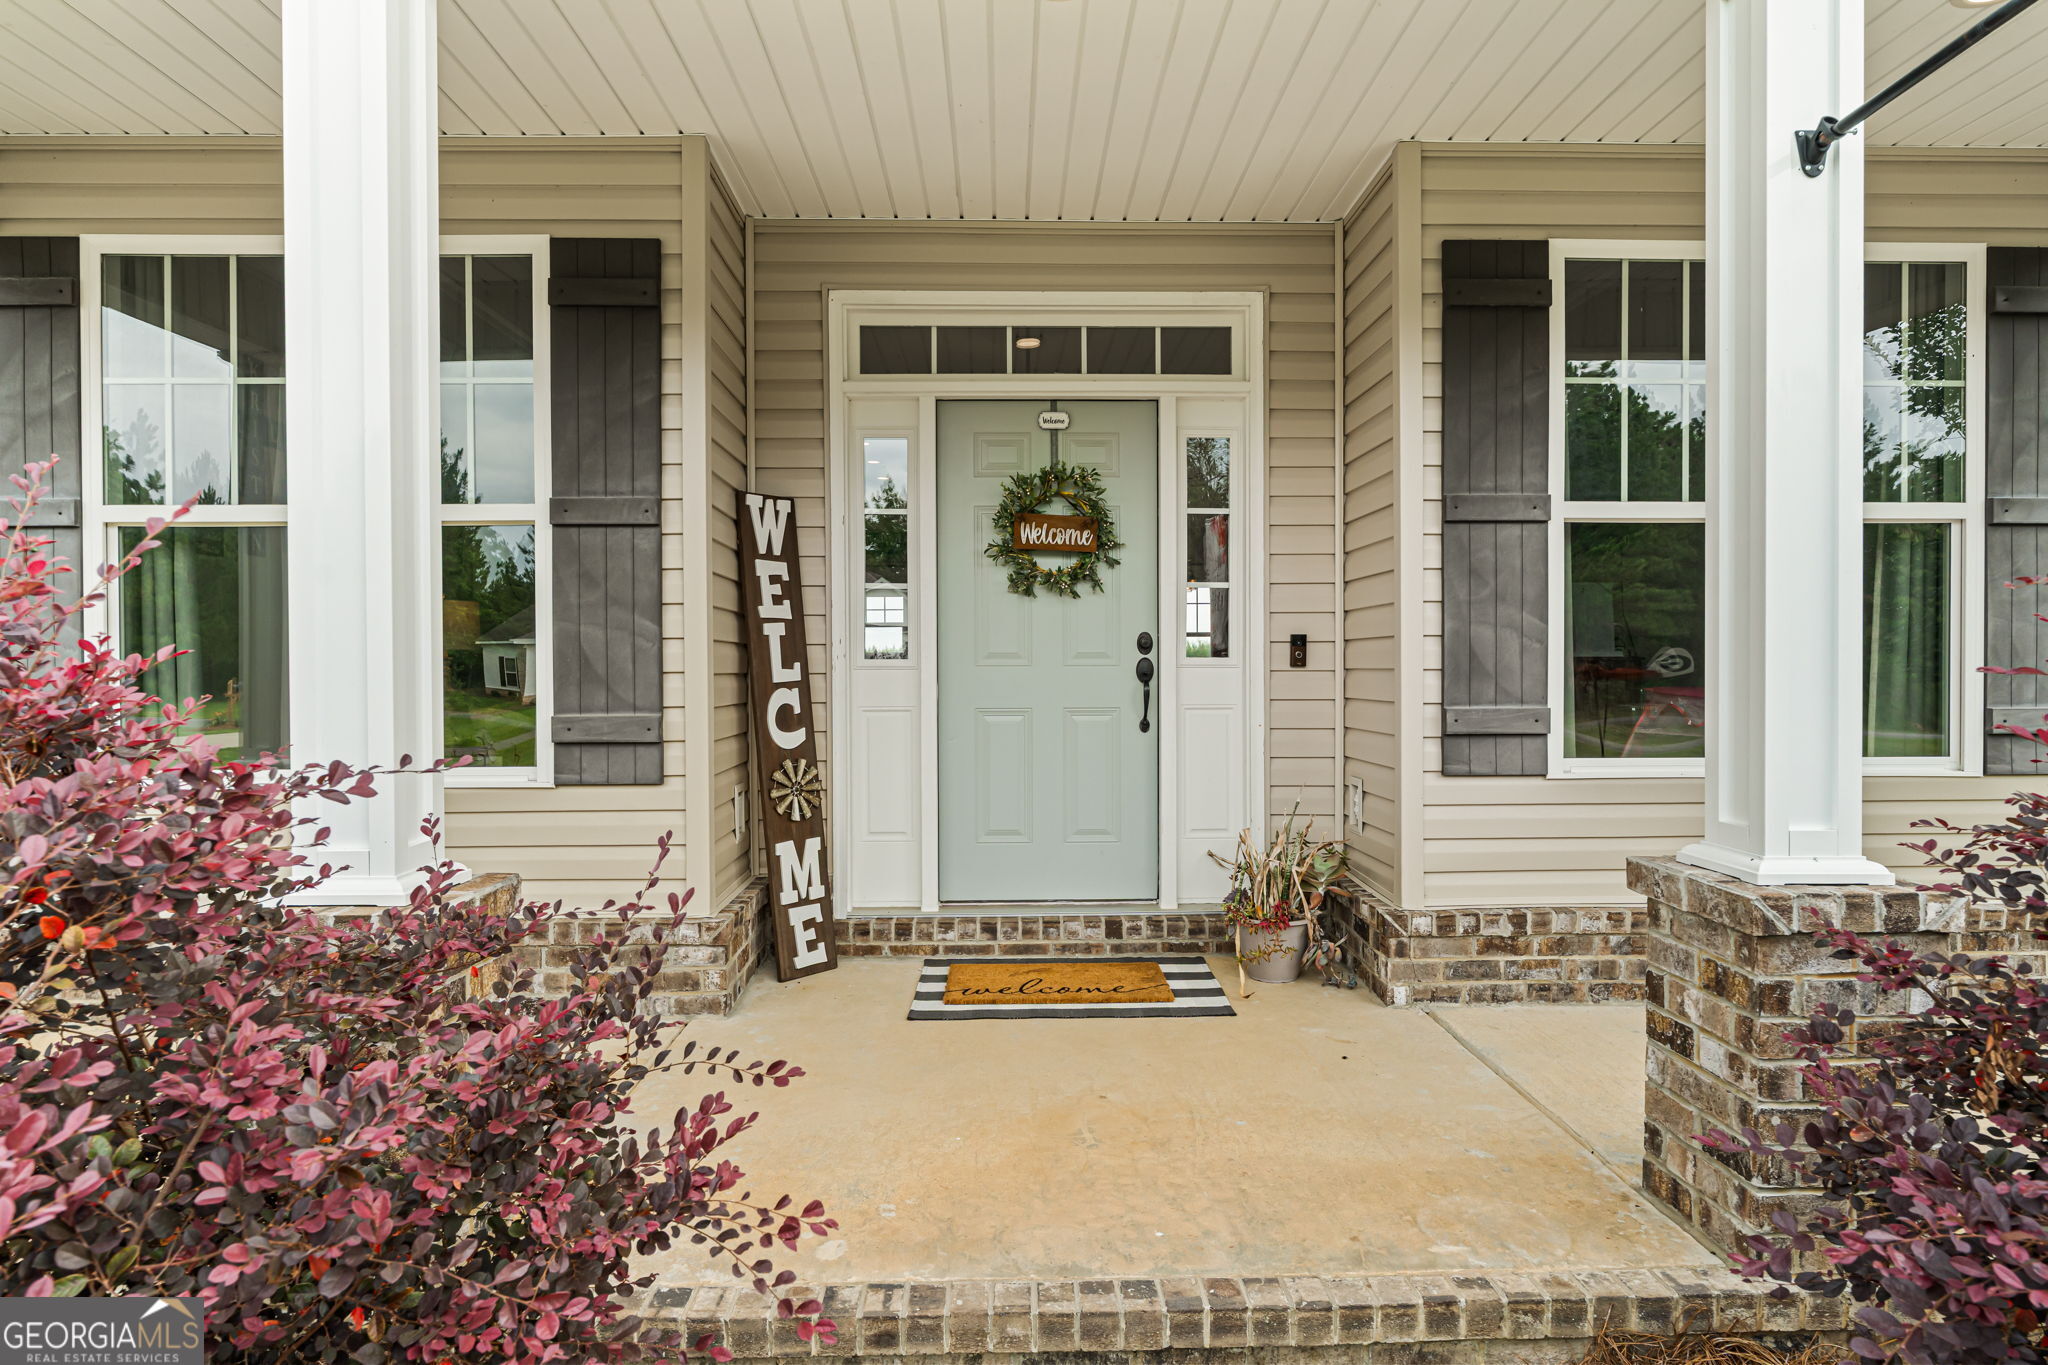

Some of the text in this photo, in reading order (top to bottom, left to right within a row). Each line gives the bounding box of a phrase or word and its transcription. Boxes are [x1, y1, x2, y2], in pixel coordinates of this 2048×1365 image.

[1042, 416, 1065, 425] Welcome
[1020, 521, 1094, 546] Welcome
[745, 494, 828, 970] WELCME
[947, 978, 1168, 996] welcome
